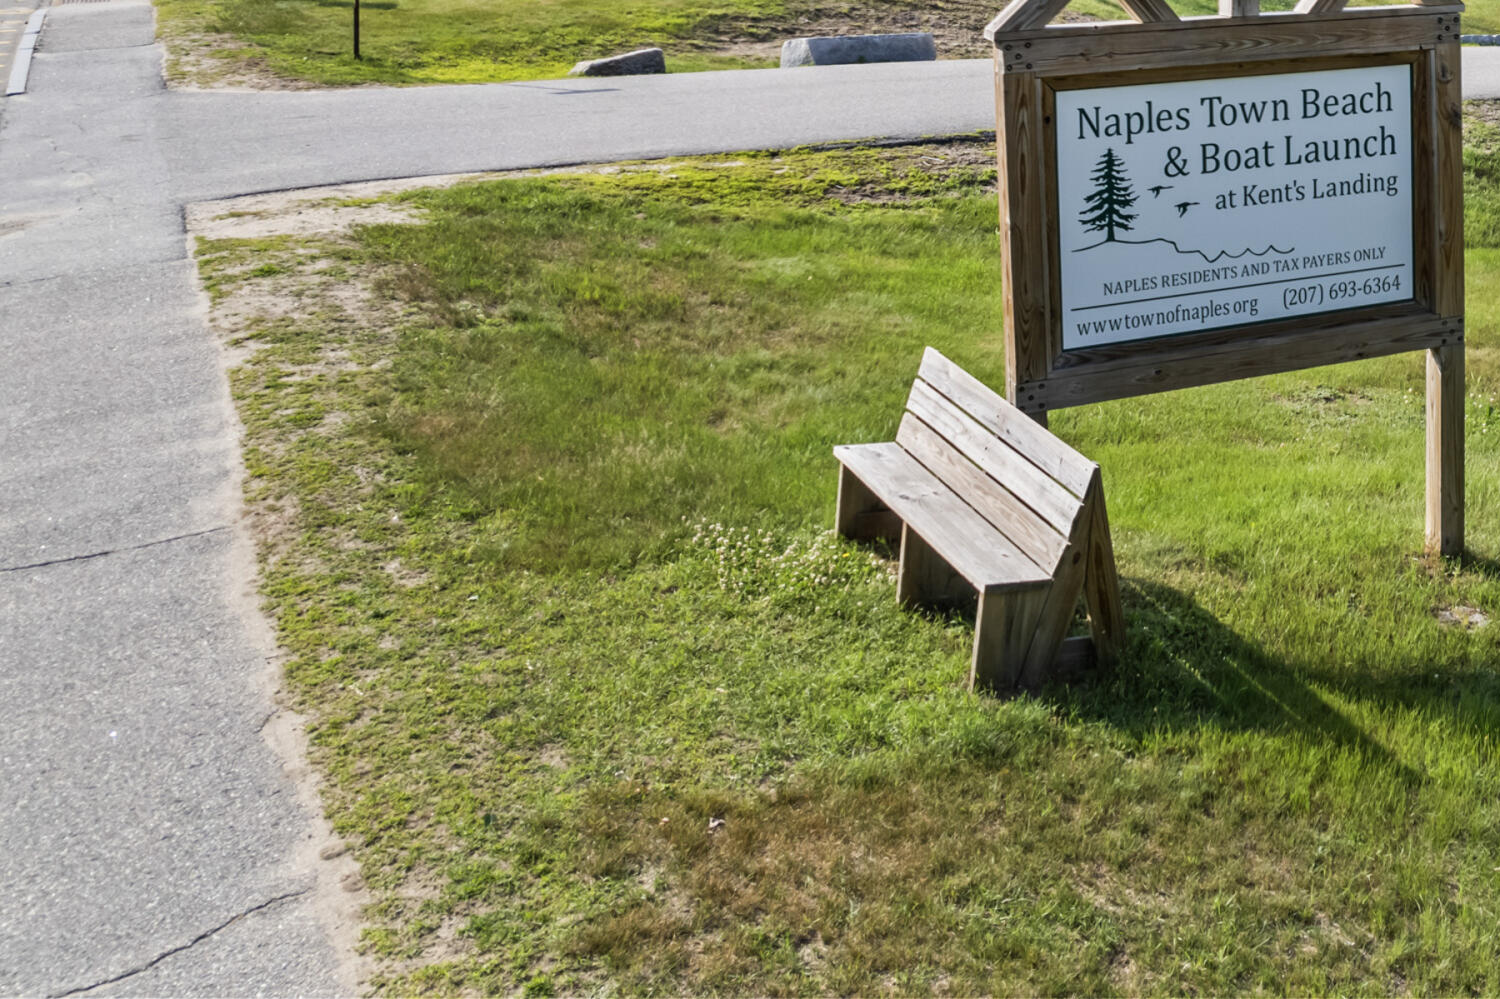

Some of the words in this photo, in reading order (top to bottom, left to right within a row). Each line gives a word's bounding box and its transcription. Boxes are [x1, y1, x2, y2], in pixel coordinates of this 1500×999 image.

[1077, 100, 1191, 145] Naples
[1200, 96, 1290, 128] Town
[1301, 82, 1393, 120] Beach
[1164, 146, 1190, 178] &
[1200, 141, 1275, 174] Boat
[1284, 125, 1397, 166] Launch
[1215, 189, 1237, 210] at
[1243, 180, 1305, 207] Kent's
[1312, 173, 1399, 197] Landing
[1103, 276, 1158, 296] NAPLES
[1161, 265, 1238, 288] RESIDENTS
[1241, 262, 1270, 278] AND
[1273, 258, 1300, 273] TAX
[1303, 251, 1350, 269] PAYERS
[1353, 246, 1386, 262] ONLY
[1283, 284, 1324, 309] (207)
[1329, 274, 1401, 300] 693-6364
